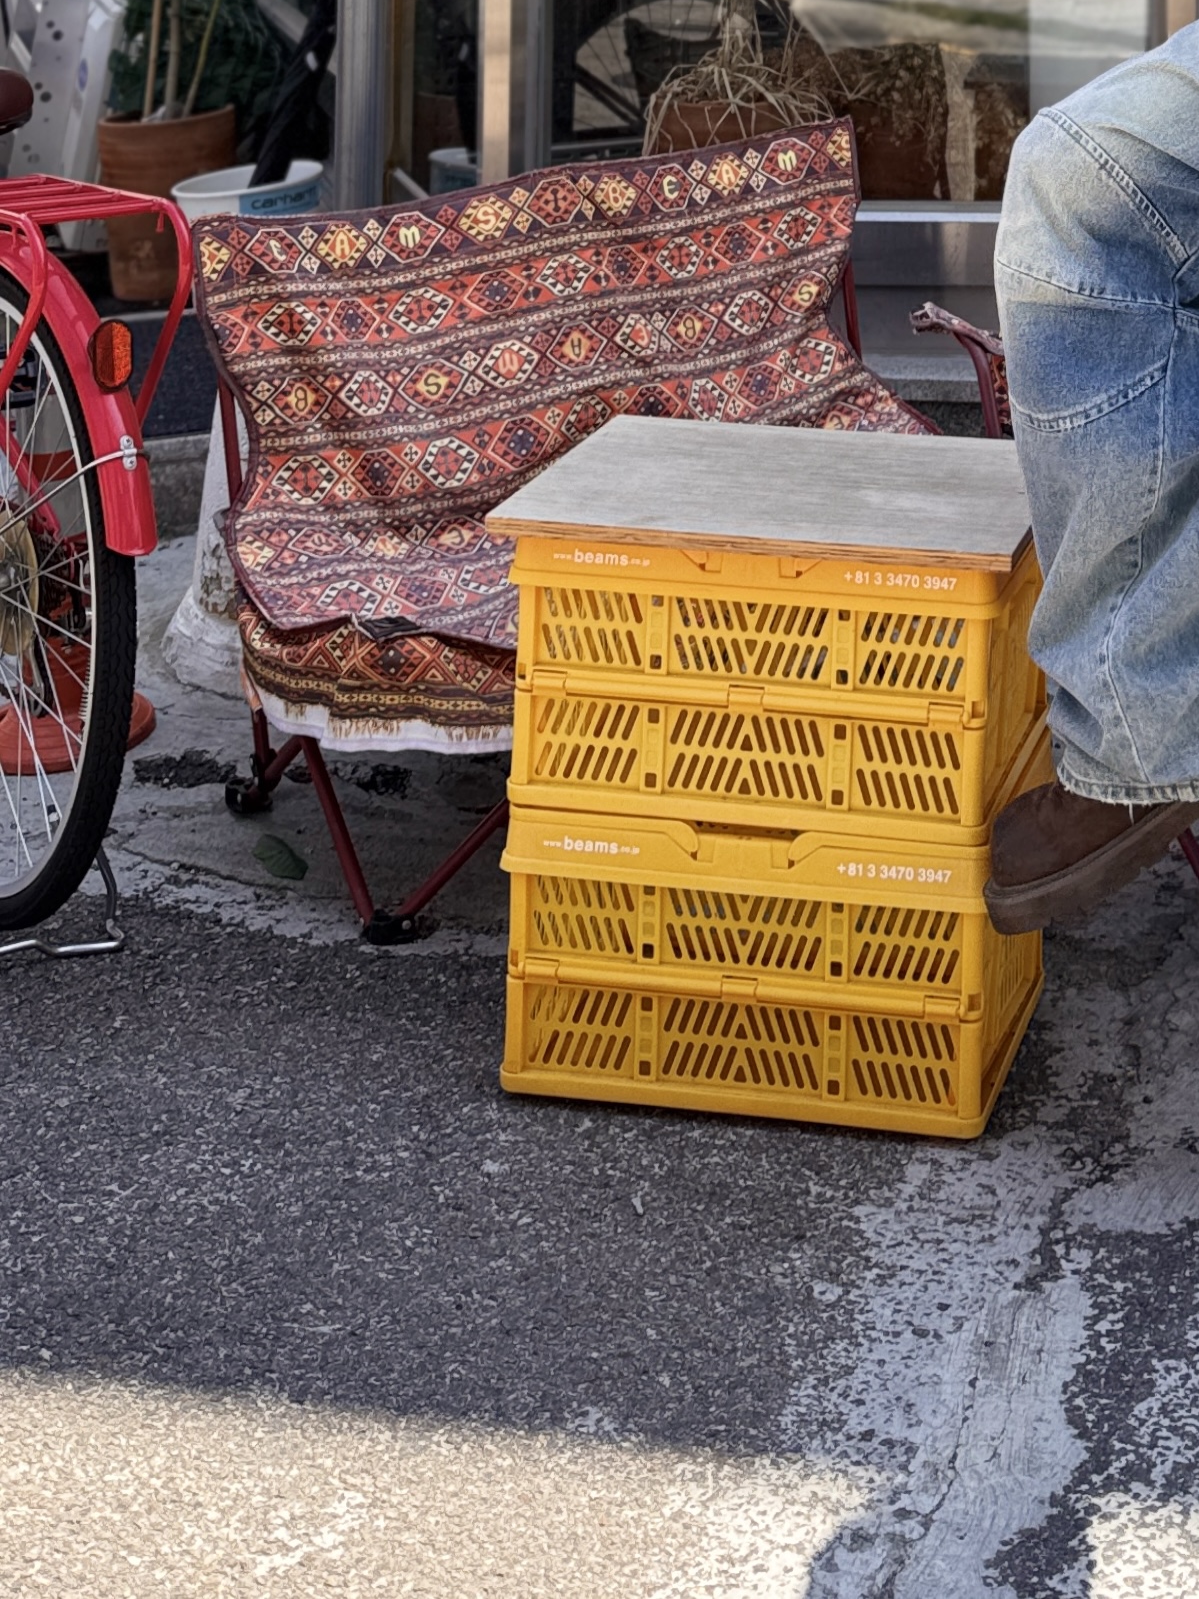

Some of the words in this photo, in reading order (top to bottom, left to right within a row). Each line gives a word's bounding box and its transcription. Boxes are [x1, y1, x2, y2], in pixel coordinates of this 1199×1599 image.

[844, 570, 870, 585] +81
[874, 571, 882, 585] 3
[886, 572, 920, 588] 3470
[923, 575, 957, 591] 3947
[837, 862, 864, 877] +81
[867, 863, 876, 877] 3
[880, 864, 914, 881] 3470
[918, 868, 952, 884] 3947
